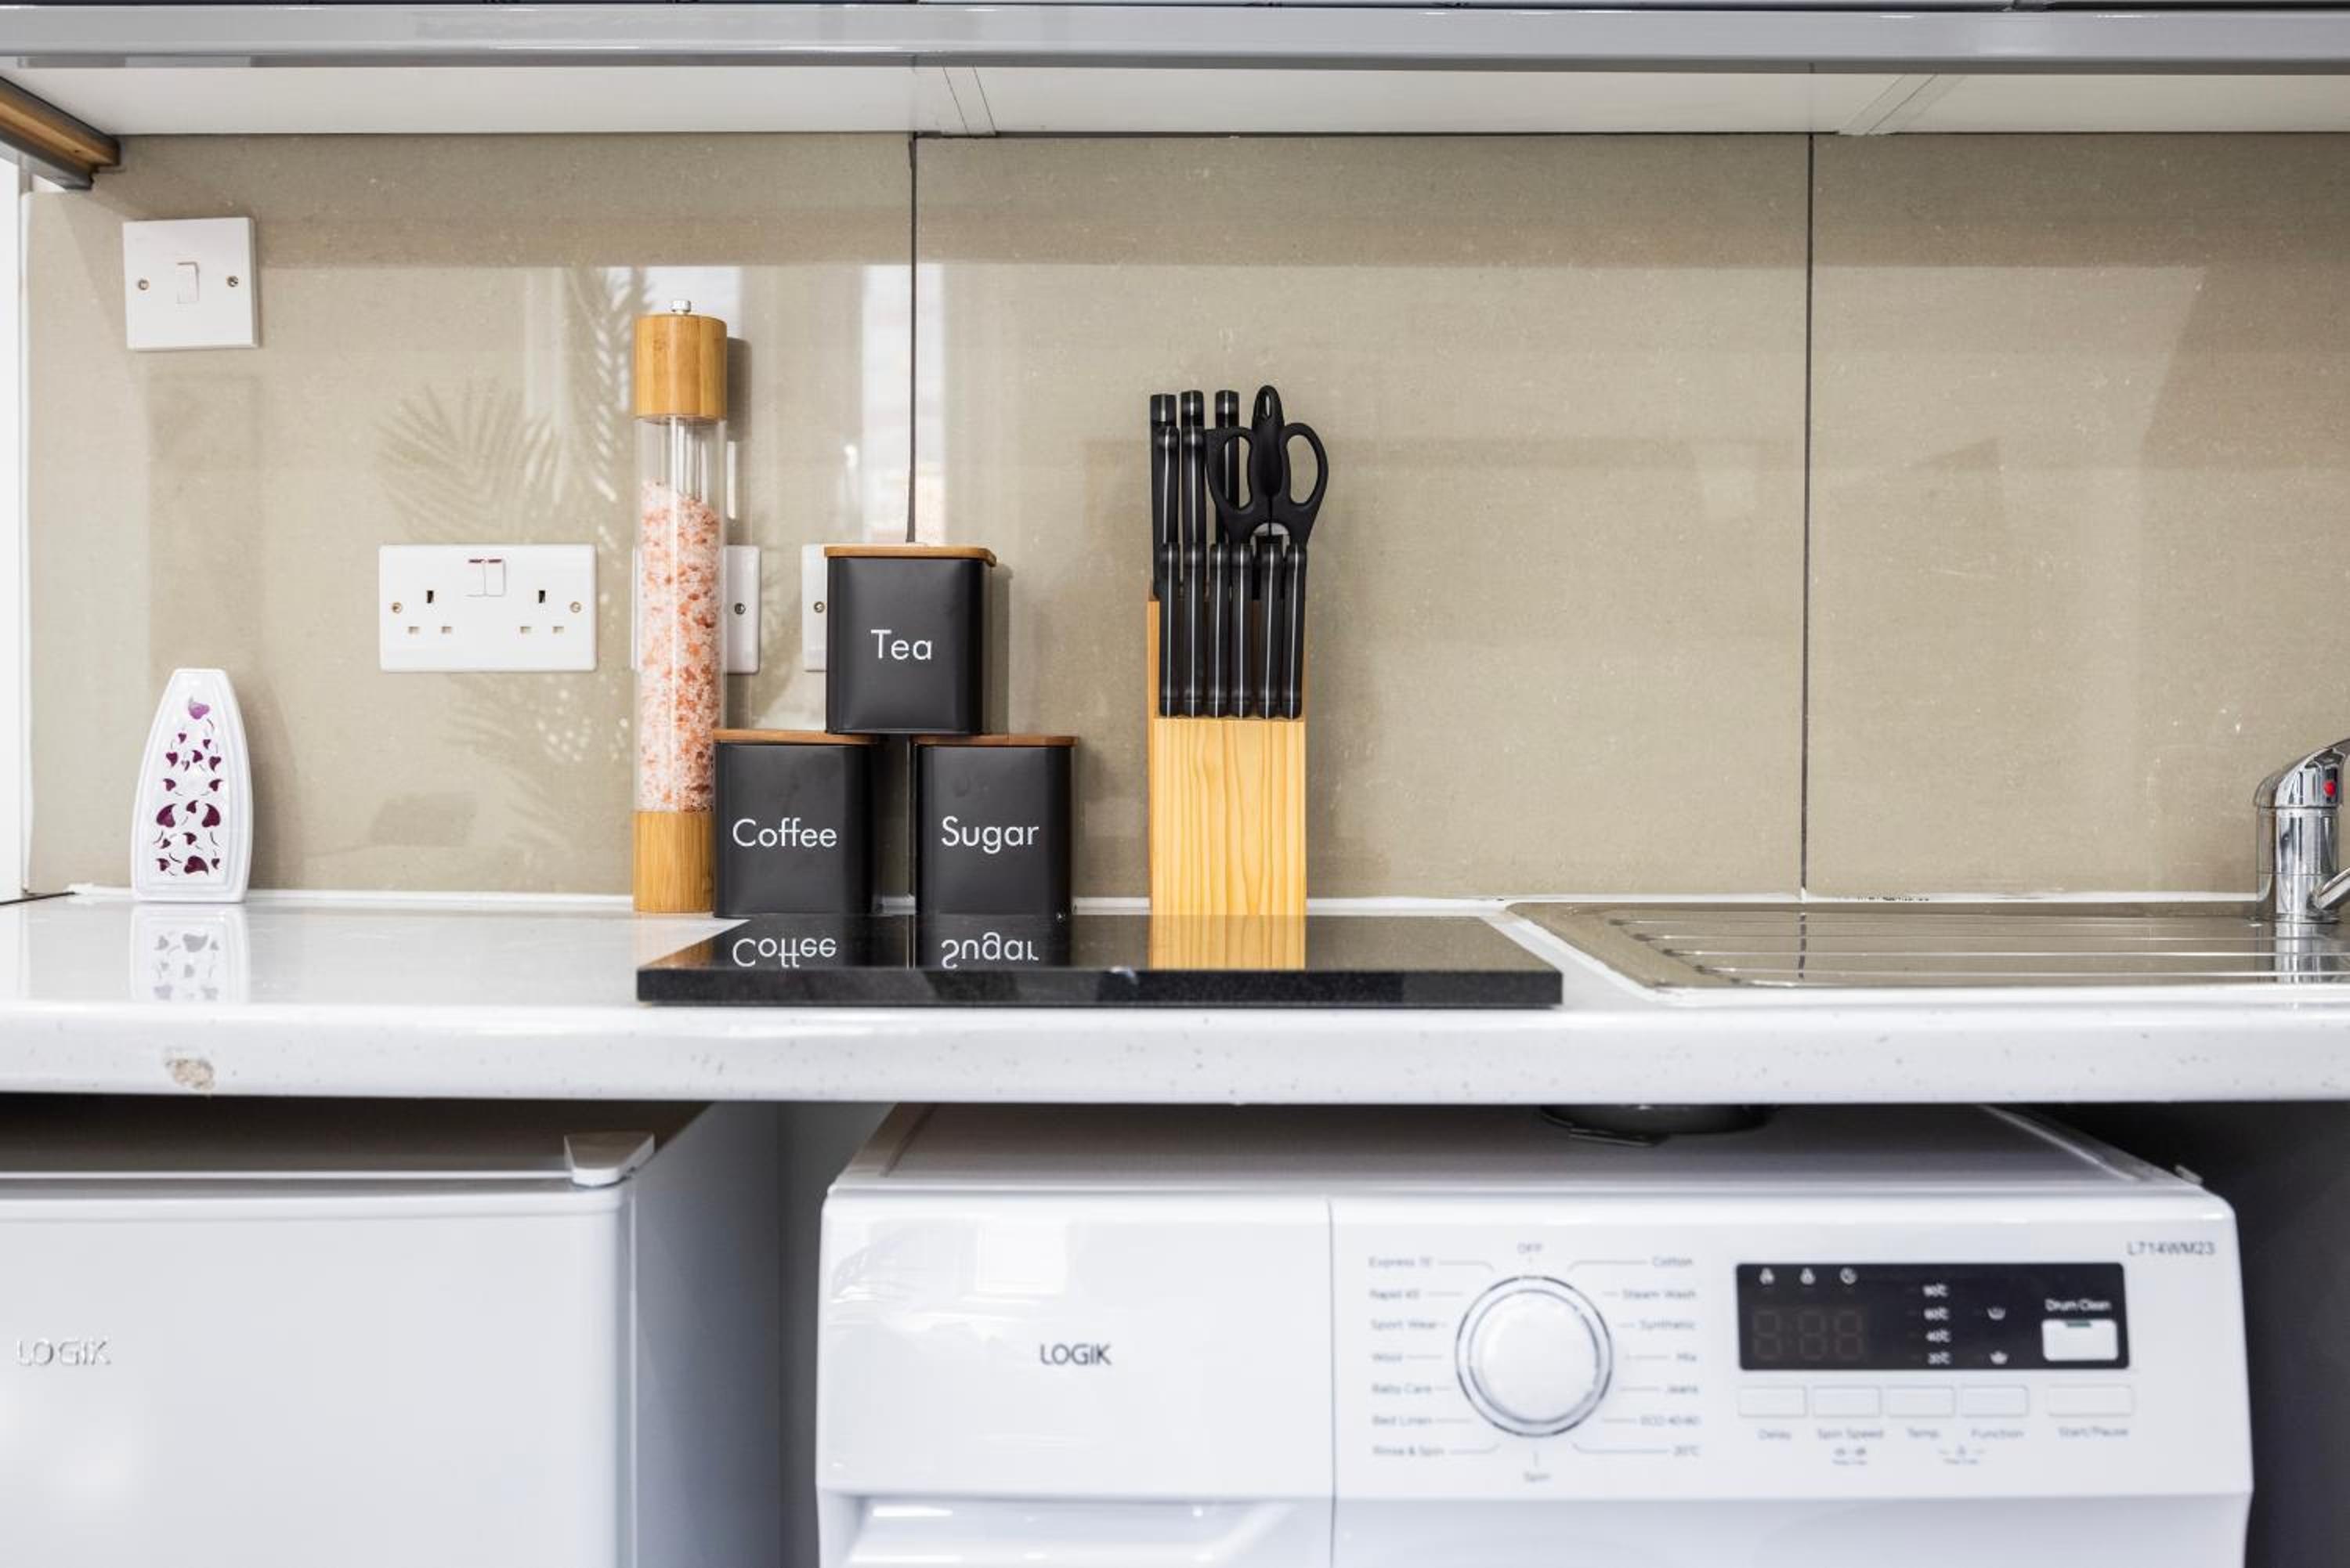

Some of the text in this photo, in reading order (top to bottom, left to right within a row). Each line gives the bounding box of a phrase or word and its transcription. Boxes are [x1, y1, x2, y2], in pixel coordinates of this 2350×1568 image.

[870, 628, 933, 661] Tea
[732, 817, 837, 848] Coffee
[941, 815, 1039, 854] Sugar
[2127, 1241, 2215, 1255] L714WM23
[2044, 1298, 2112, 1312] Drum Clean
[15, 1337, 112, 1367] LOGIK
[1039, 1342, 1113, 1366] LOGIK
[1969, 1428, 2026, 1440] Function
[2058, 1425, 2129, 1439] Start/Pause
